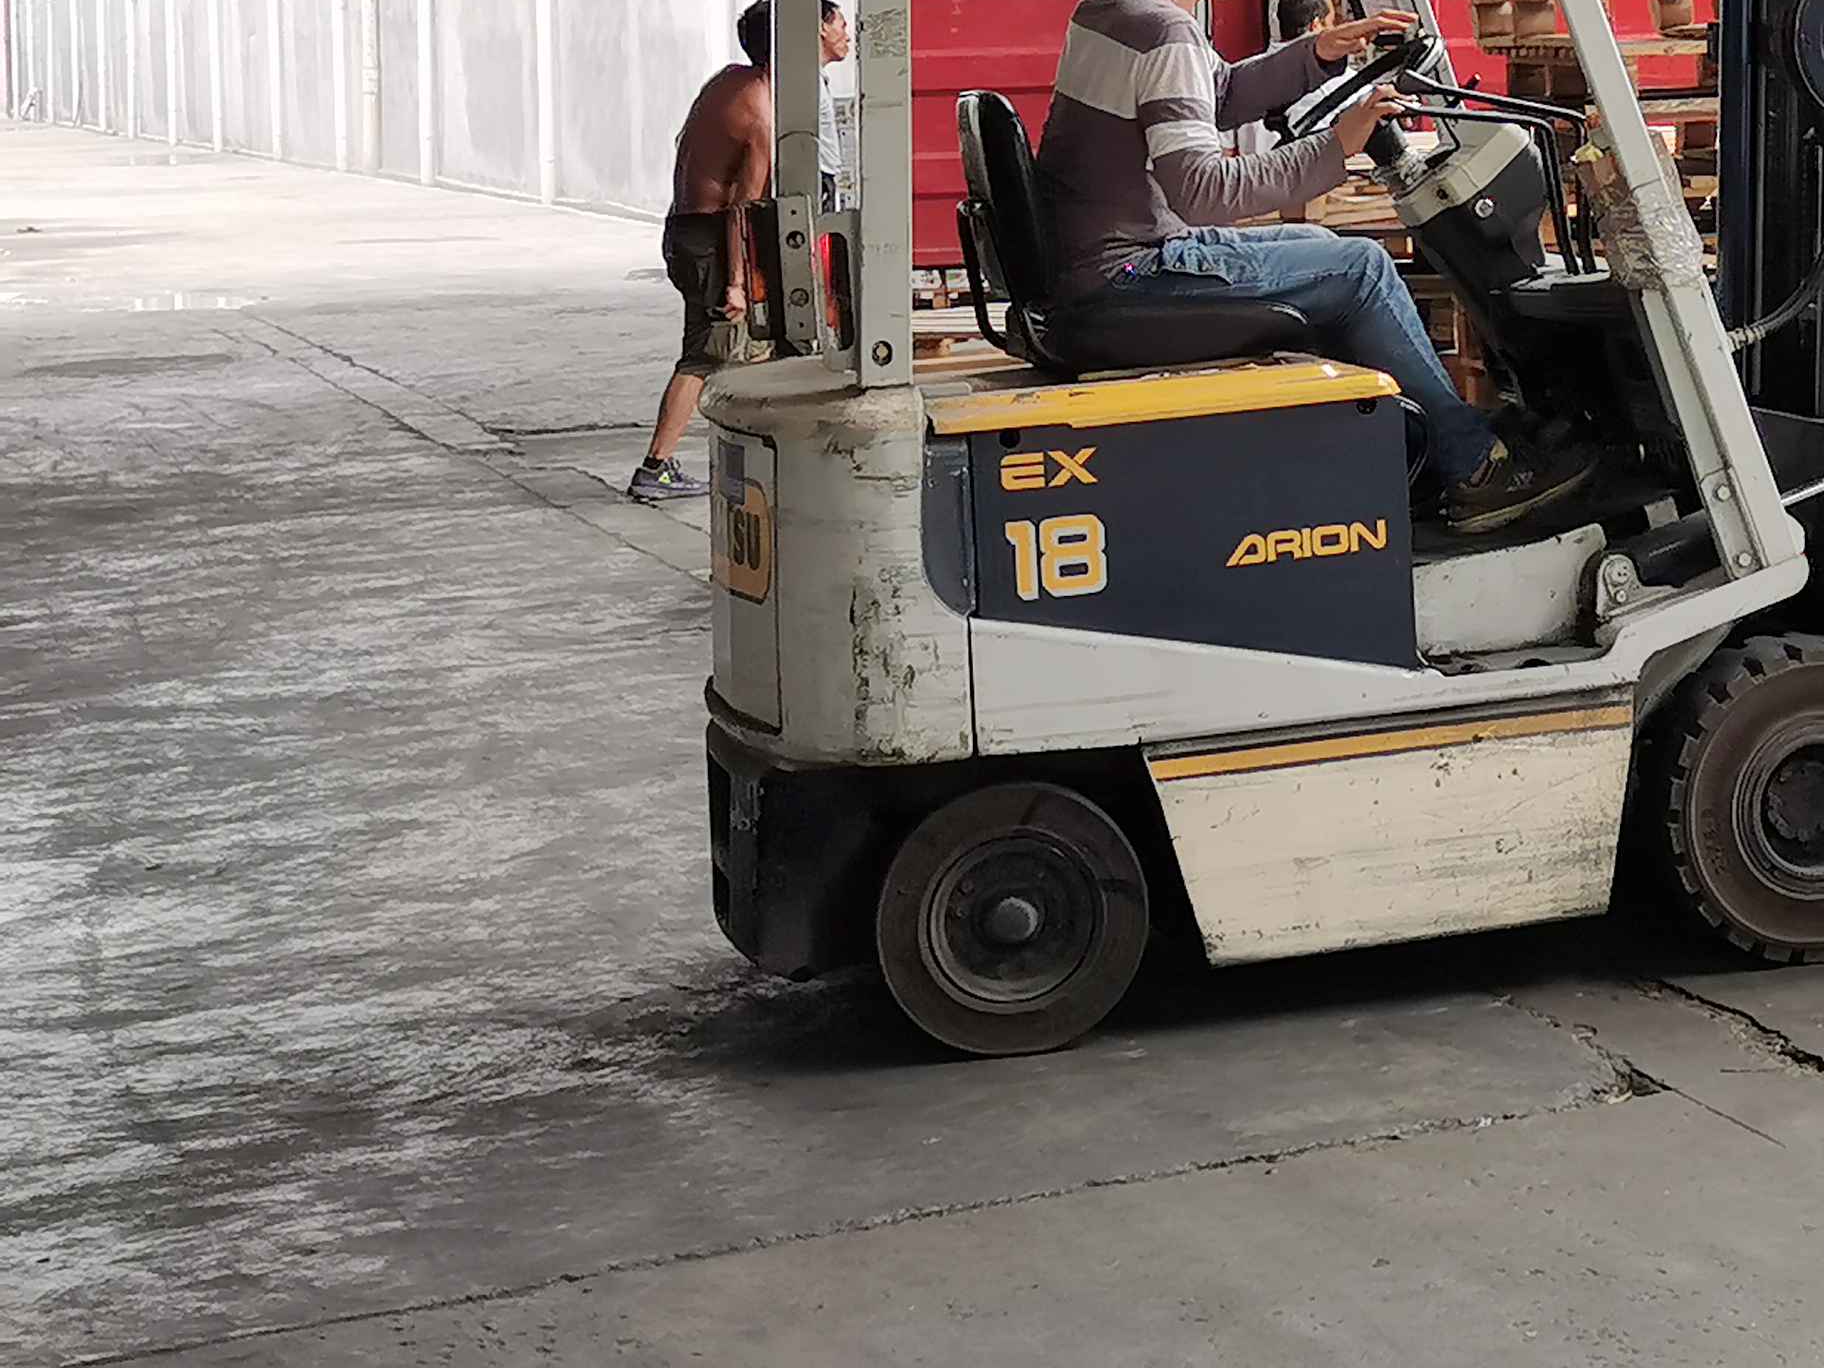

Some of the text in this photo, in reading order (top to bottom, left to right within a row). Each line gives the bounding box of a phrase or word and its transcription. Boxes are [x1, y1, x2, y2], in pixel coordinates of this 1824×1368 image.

[1000, 447, 1098, 491] EX
[1005, 514, 1108, 601] 18
[1226, 519, 1388, 567] ARION
